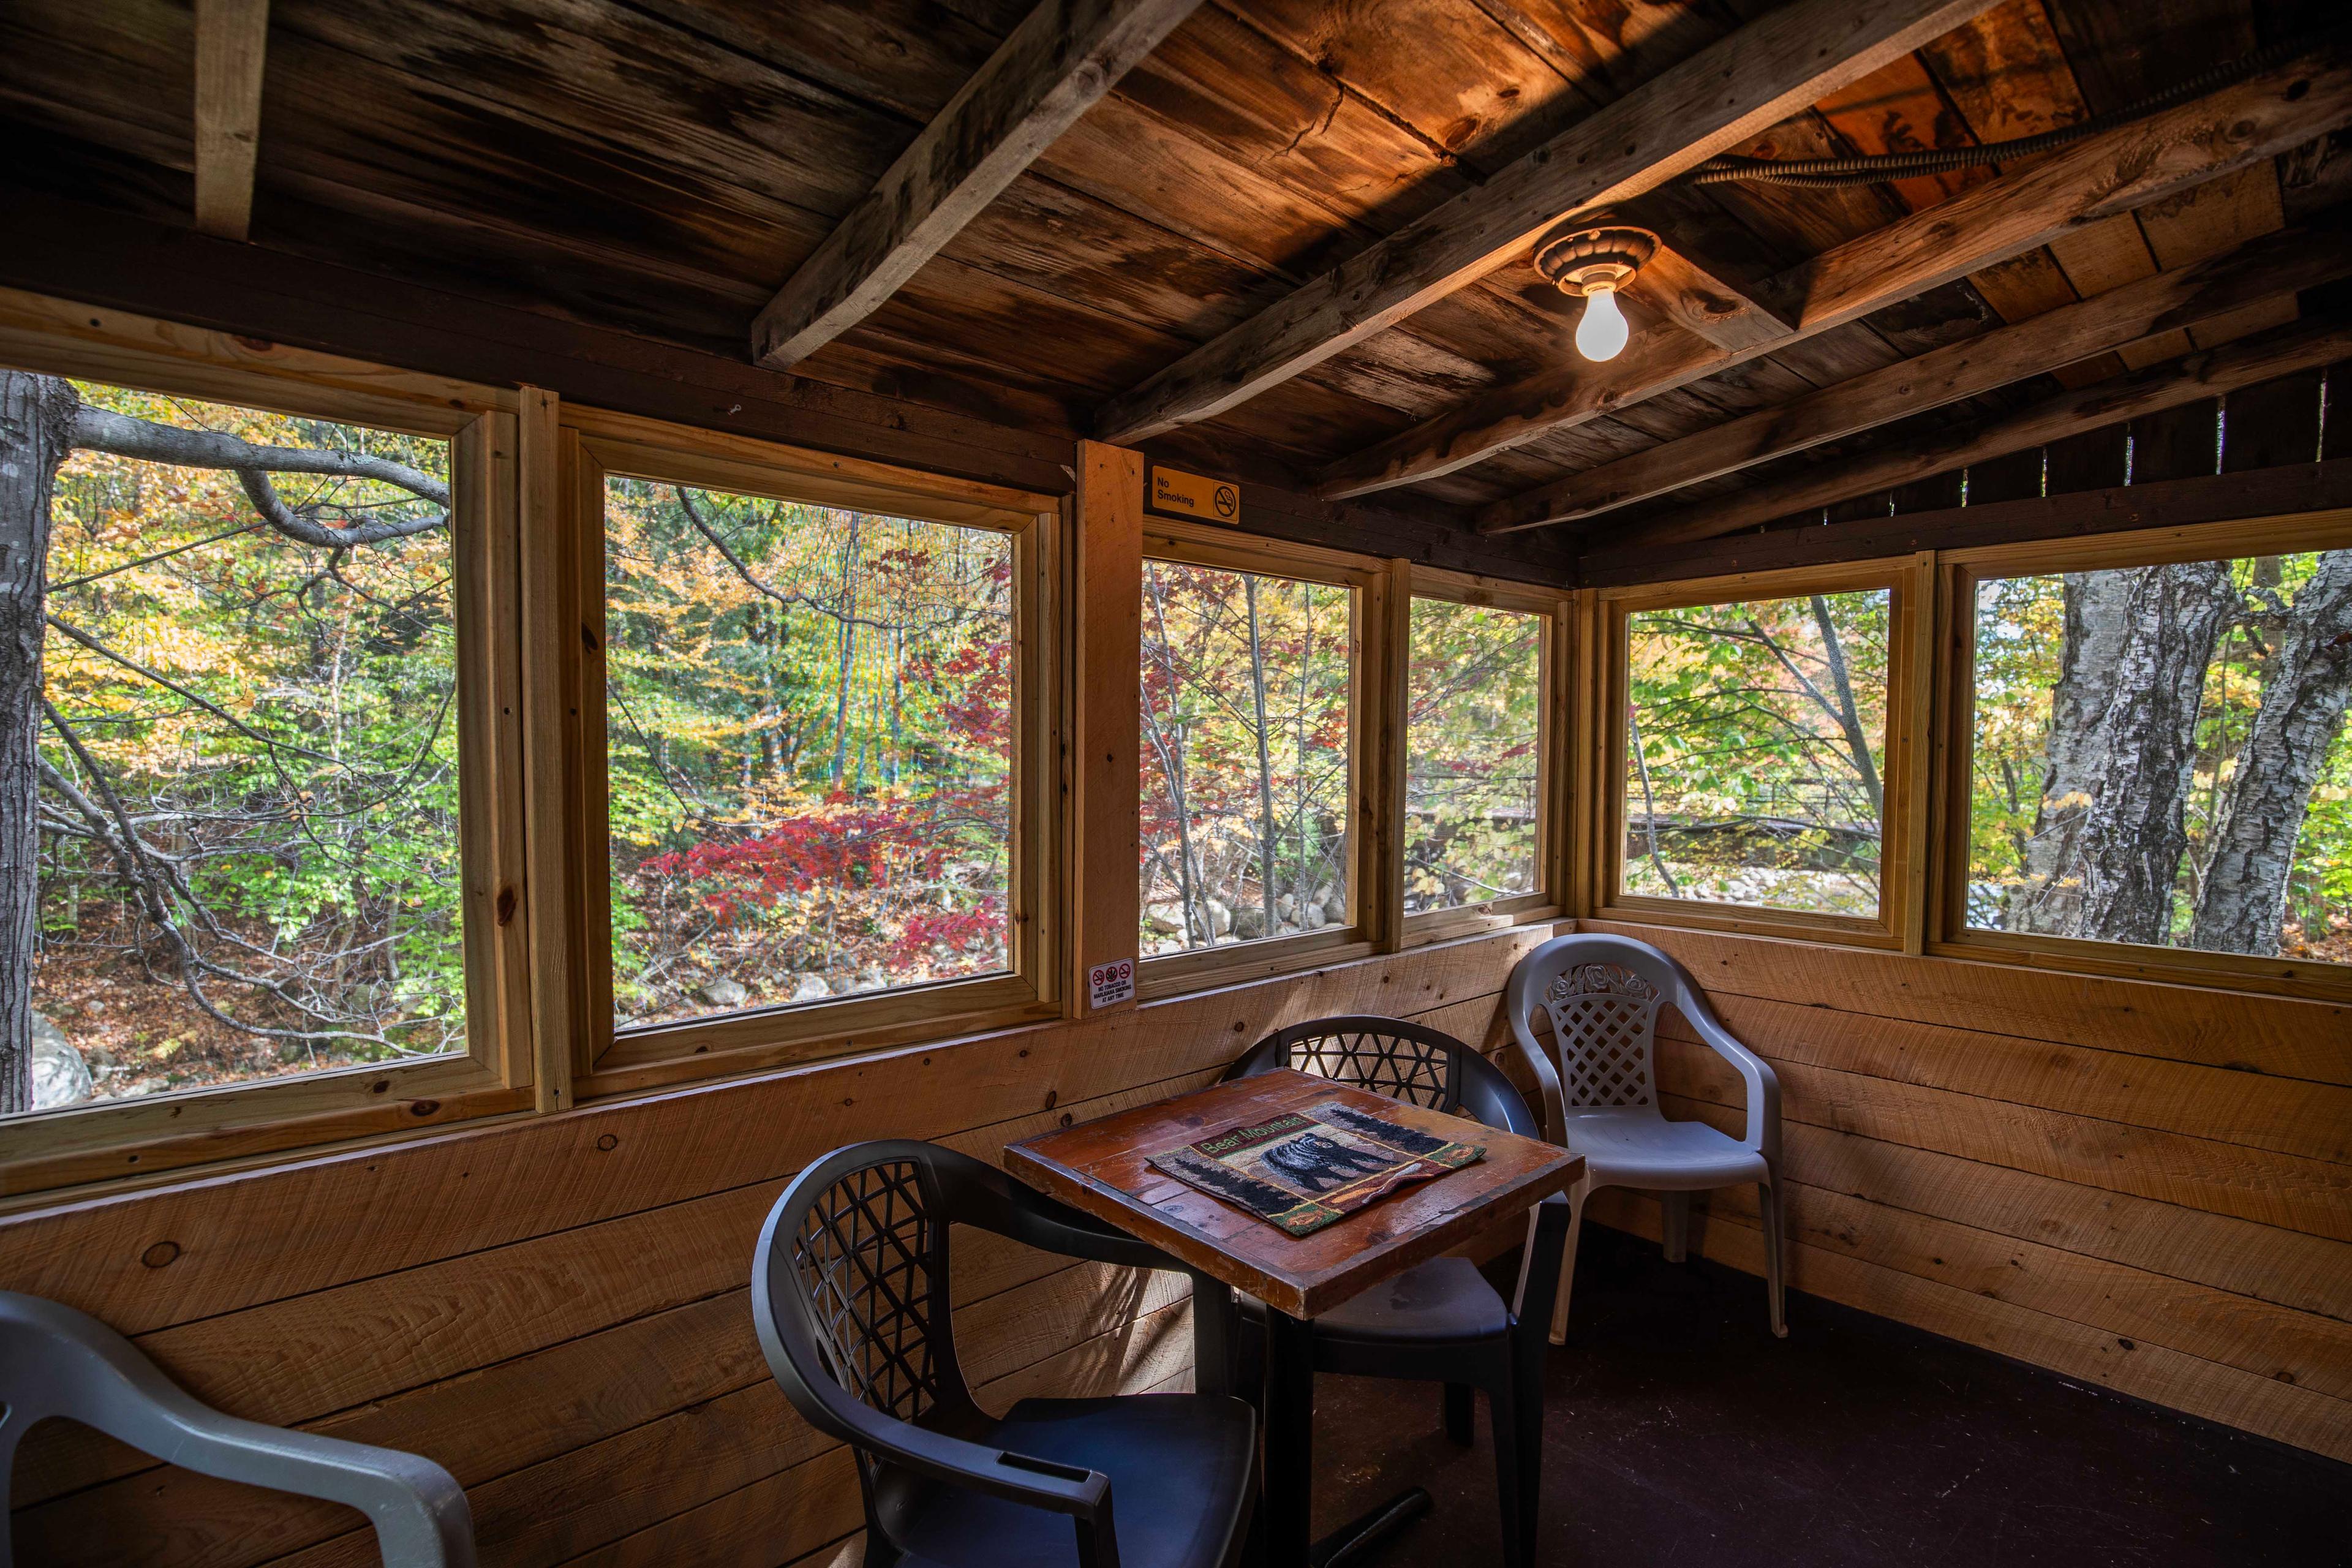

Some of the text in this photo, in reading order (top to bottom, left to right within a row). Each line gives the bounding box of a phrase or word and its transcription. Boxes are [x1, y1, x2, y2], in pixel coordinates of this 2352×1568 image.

[1157, 477, 1169, 488] No
[1158, 489, 1194, 508] Smoking
[1093, 984, 1132, 1000] MARIJUANA SMOKING
[1104, 982, 1121, 990] TOBACCO
[1200, 1116, 1308, 1154] Bear Mountain
